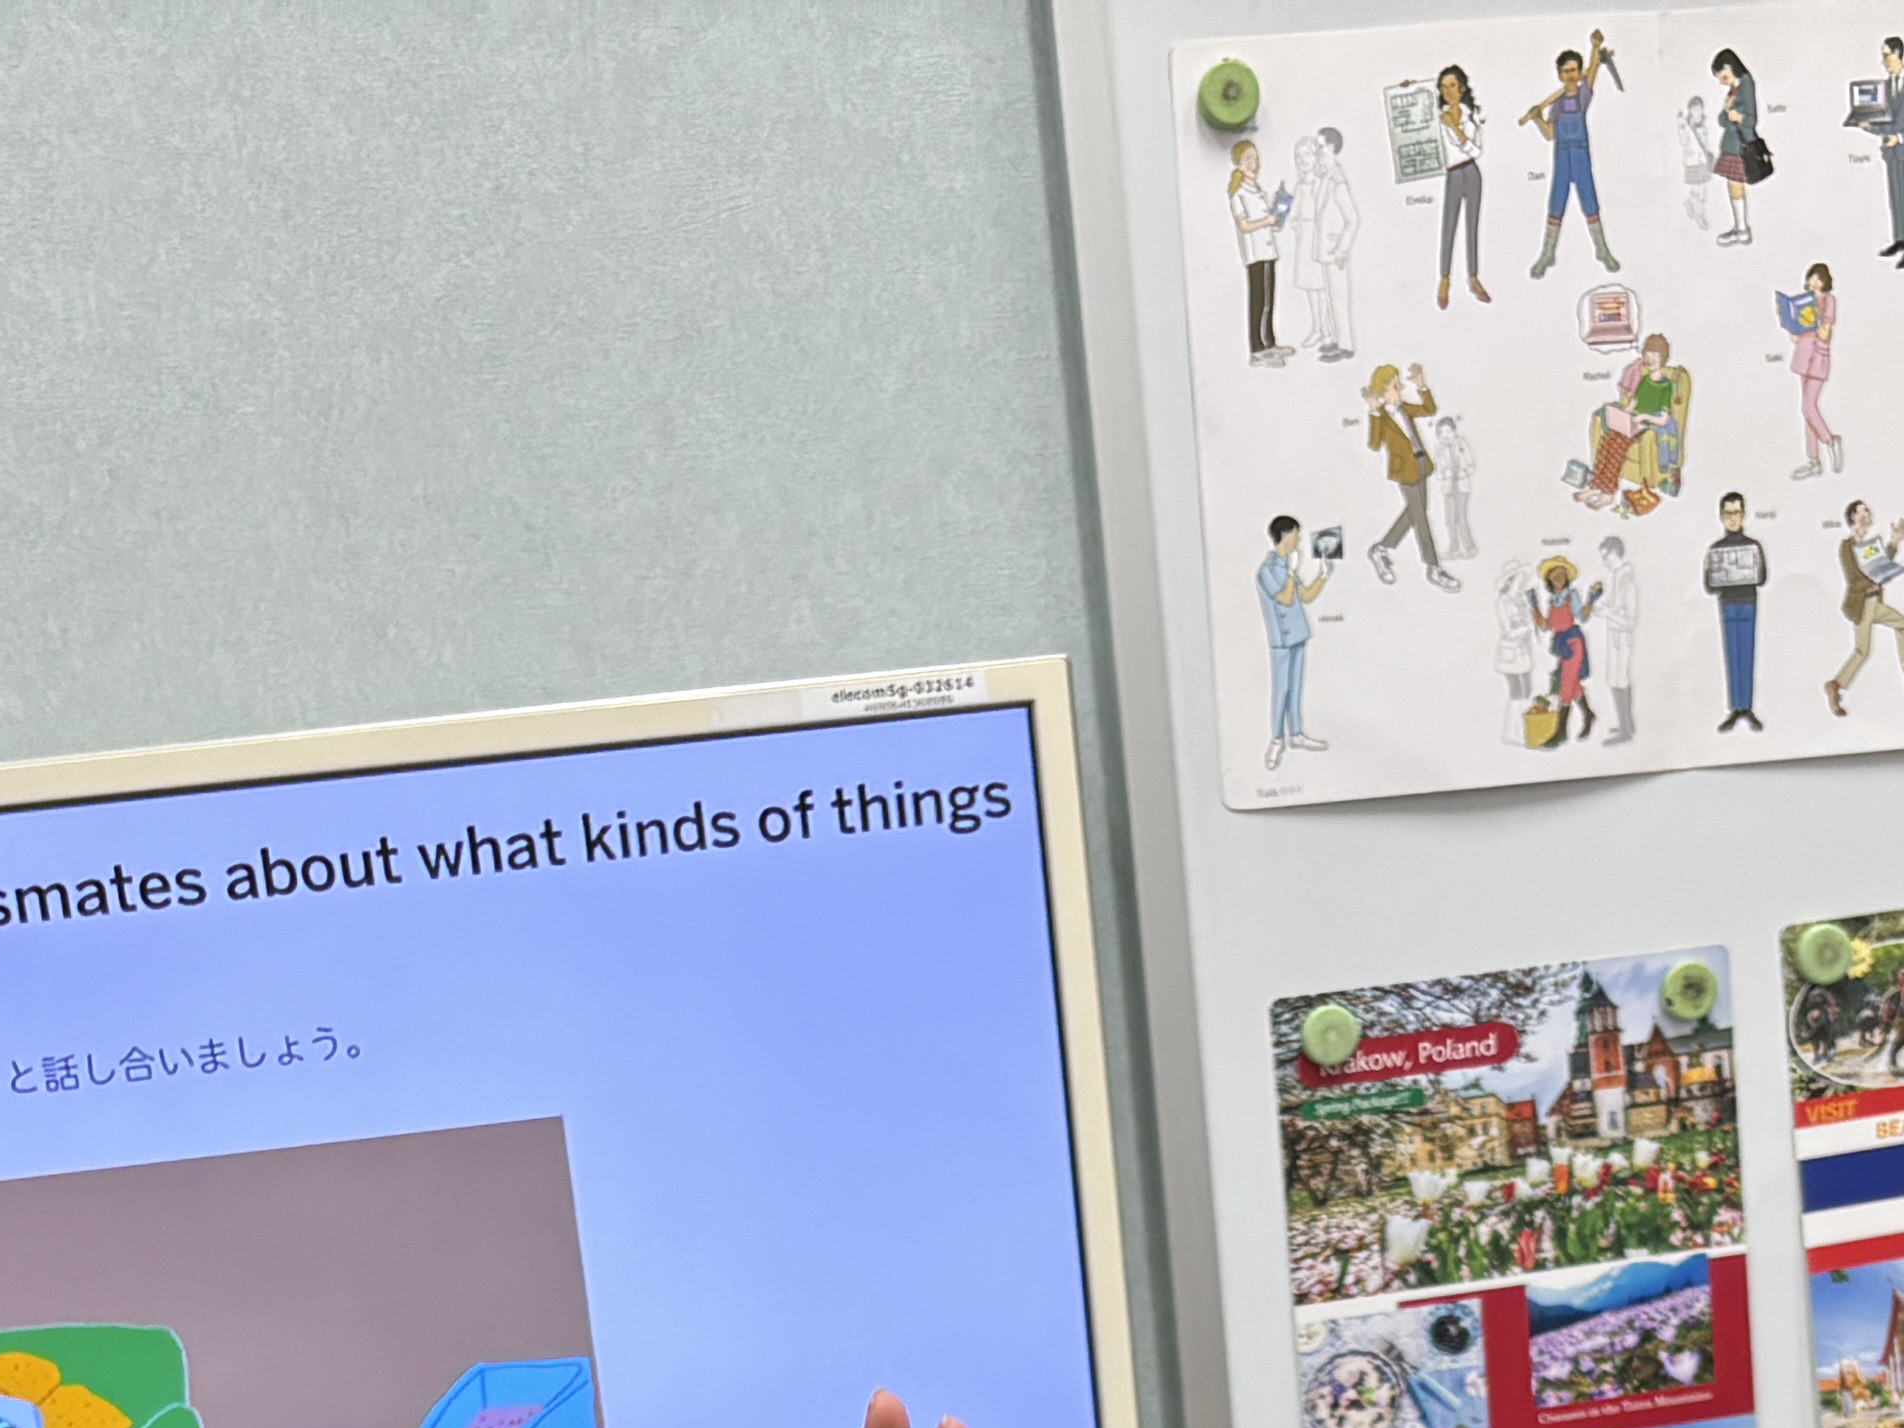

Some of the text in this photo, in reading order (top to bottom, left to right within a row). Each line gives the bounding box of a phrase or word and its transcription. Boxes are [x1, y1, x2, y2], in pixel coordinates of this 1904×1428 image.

[226, 837, 403, 902] about
[418, 818, 567, 881] what
[582, 800, 741, 863] kinds
[758, 789, 815, 845] of
[831, 776, 1013, 835] things
[1418, 1032, 1496, 1064] Poland
[1805, 1100, 1858, 1124] VISIT
